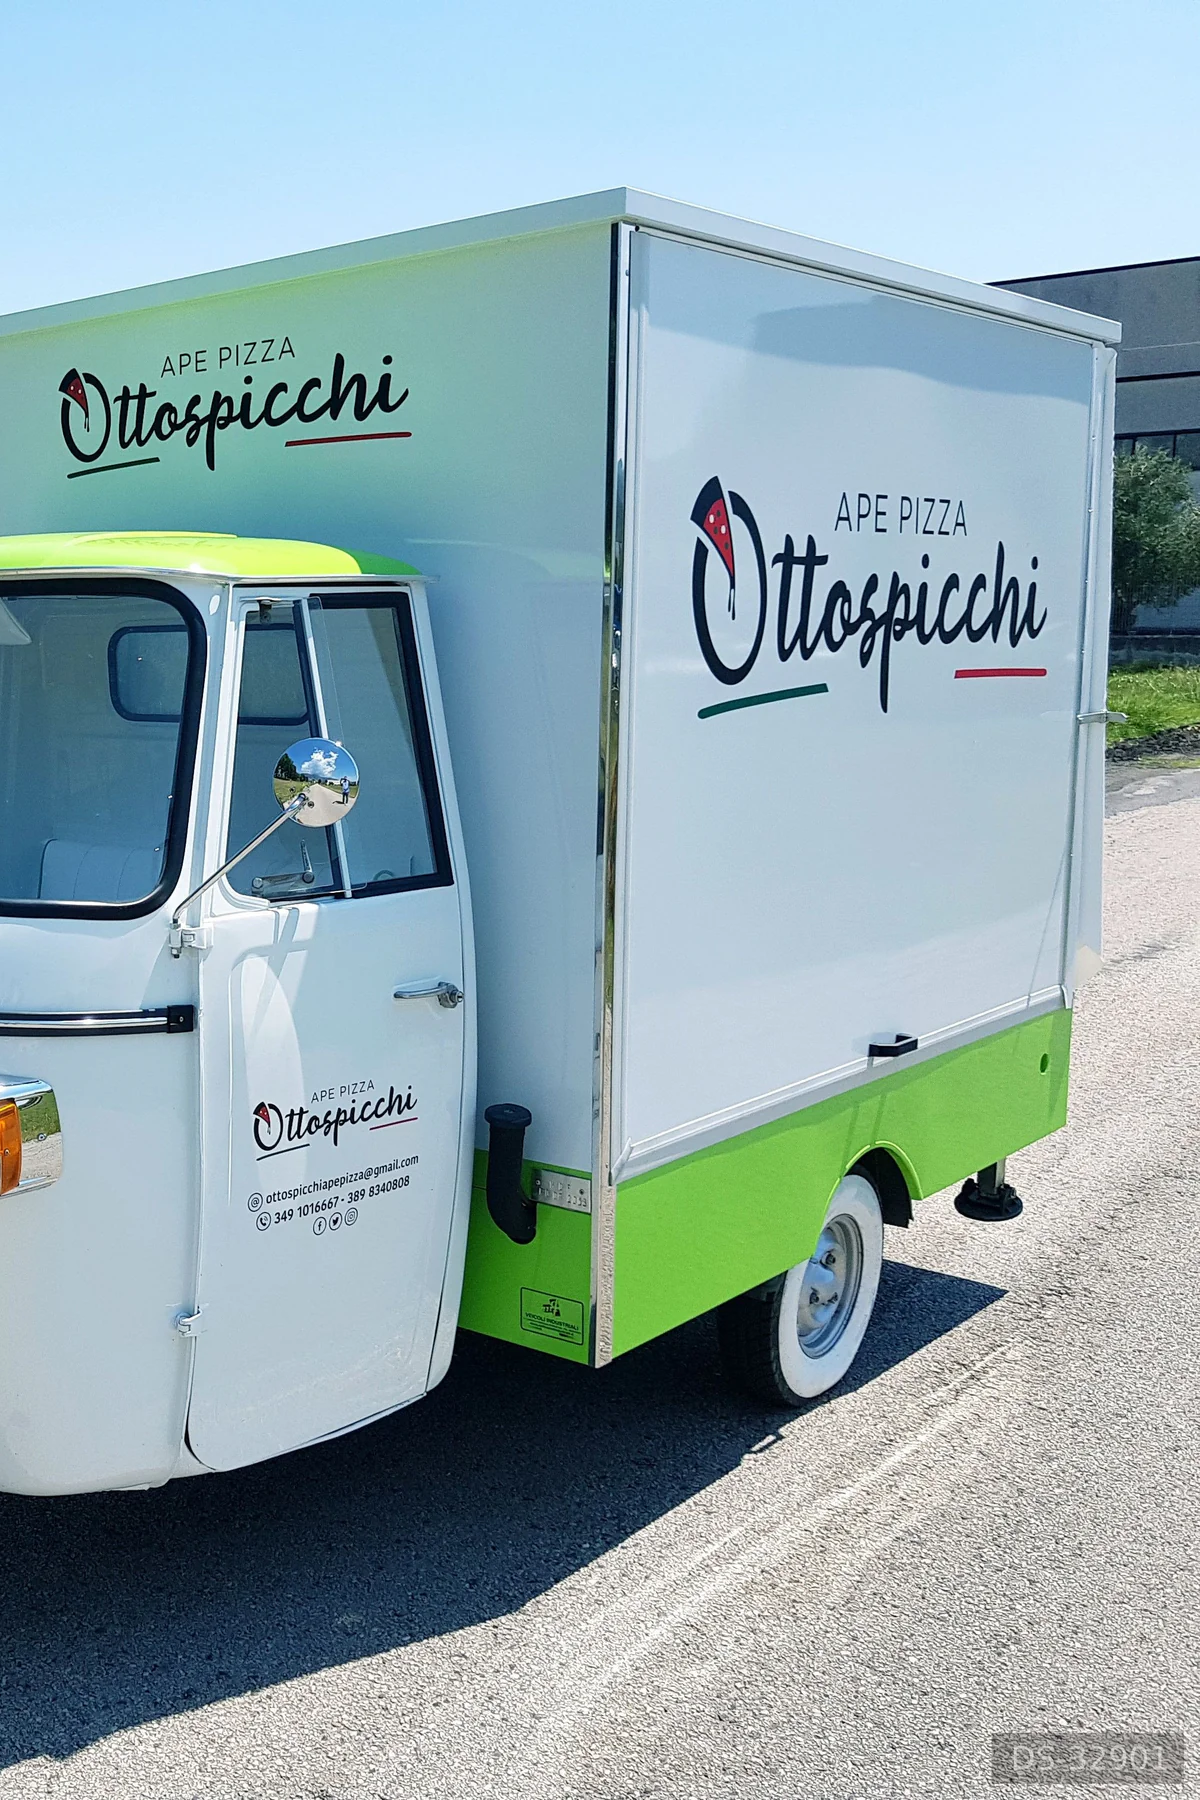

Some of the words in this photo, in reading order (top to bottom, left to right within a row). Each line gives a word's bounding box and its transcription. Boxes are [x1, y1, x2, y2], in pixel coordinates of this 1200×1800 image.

[160, 350, 208, 379] APE
[218, 336, 296, 370] PIZZA
[58, 352, 410, 472] Ottospicchi
[834, 491, 888, 533] APE
[899, 496, 968, 537] PIZZA
[690, 476, 1048, 714] Ottospicchi
[311, 1088, 335, 1103] APE
[340, 1079, 375, 1097] PIZZA
[253, 1085, 418, 1151] Ottospicchi
[265, 1155, 419, 1204] ottospicchiapepizza@gmail.com
[274, 1208, 294, 1224] 349
[297, 1195, 339, 1218] 1016667
[347, 1188, 366, 1204] 389
[368, 1175, 410, 1198] 8340808
